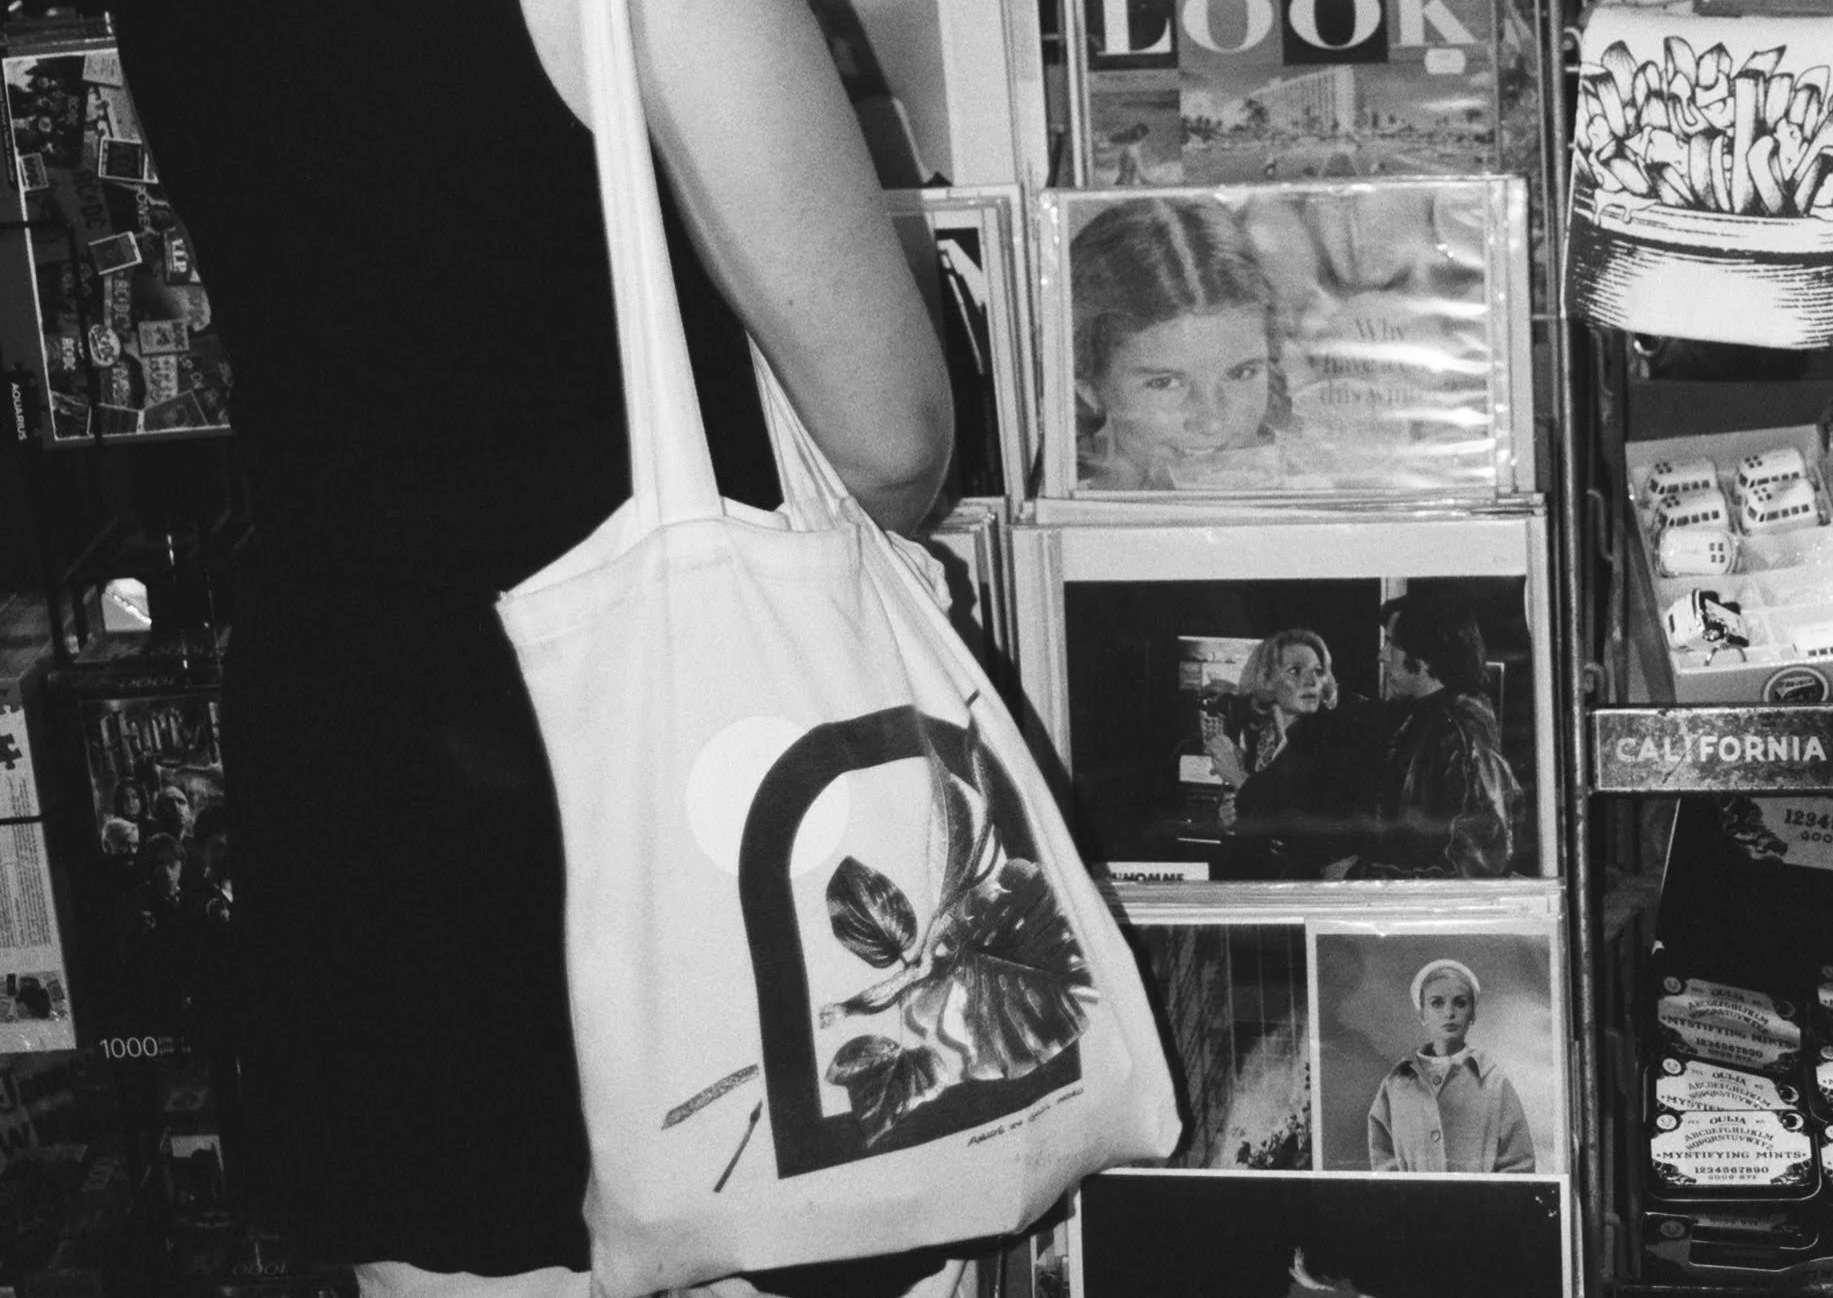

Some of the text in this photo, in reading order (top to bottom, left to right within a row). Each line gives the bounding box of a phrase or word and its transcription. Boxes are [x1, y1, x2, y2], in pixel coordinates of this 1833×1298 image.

[10, 382, 28, 441] AQUARIUS
[1615, 733, 1829, 764] CALIFORNIA
[99, 1035, 159, 1060] 1000
[1662, 1151, 1802, 1159] MYSTIFYING MINTS
